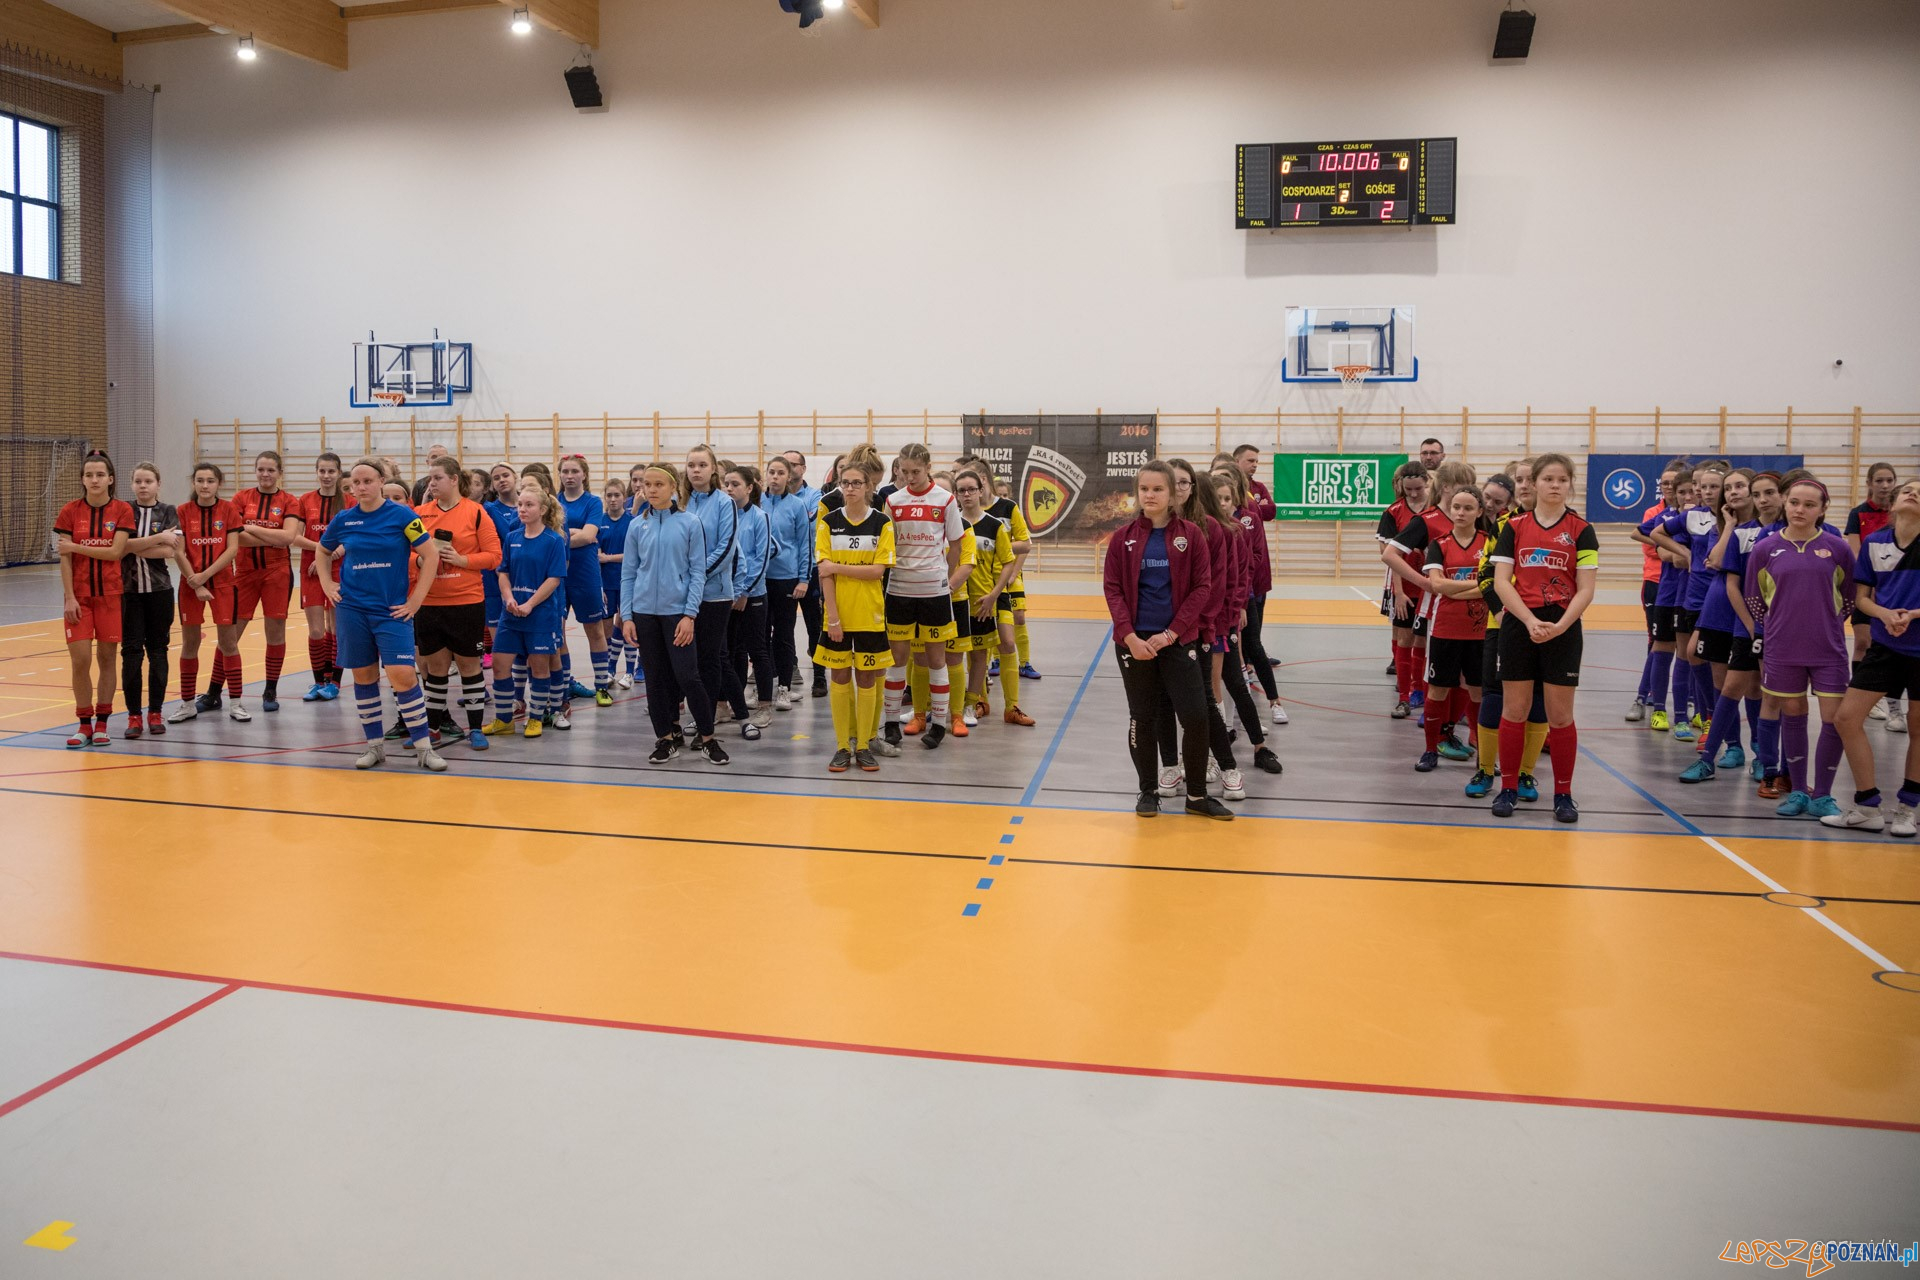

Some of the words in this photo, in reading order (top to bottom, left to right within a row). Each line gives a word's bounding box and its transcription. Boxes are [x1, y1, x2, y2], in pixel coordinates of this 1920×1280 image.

[1281, 161, 1291, 174] 0
[1399, 158, 1409, 171] 0
[1282, 185, 1336, 197] GOSPODARZE
[1365, 181, 1396, 195] GOŚCIE
[1339, 189, 1350, 203] 2
[1294, 203, 1301, 220] 1
[1380, 200, 1395, 219] 2
[970, 426, 986, 437] KA
[987, 426, 994, 435] 4
[1120, 423, 1149, 438] 2016
[971, 447, 1013, 461] WALCZ!
[1106, 449, 1148, 465] JESTEŚ
[998, 463, 1013, 475] SIĘ
[1106, 468, 1139, 478] ZWYCIĘZ
[1307, 463, 1352, 485] JUST
[1307, 484, 1353, 504] GIRLS
[910, 507, 923, 518] 20
[191, 536, 223, 546] oponeo
[906, 532, 911, 540] 4
[848, 537, 860, 549] 26
[928, 628, 940, 639] 16
[945, 639, 955, 650] 12
[973, 636, 984, 646] 32
[1752, 638, 1763, 654] 6
[863, 654, 876, 667] 26
